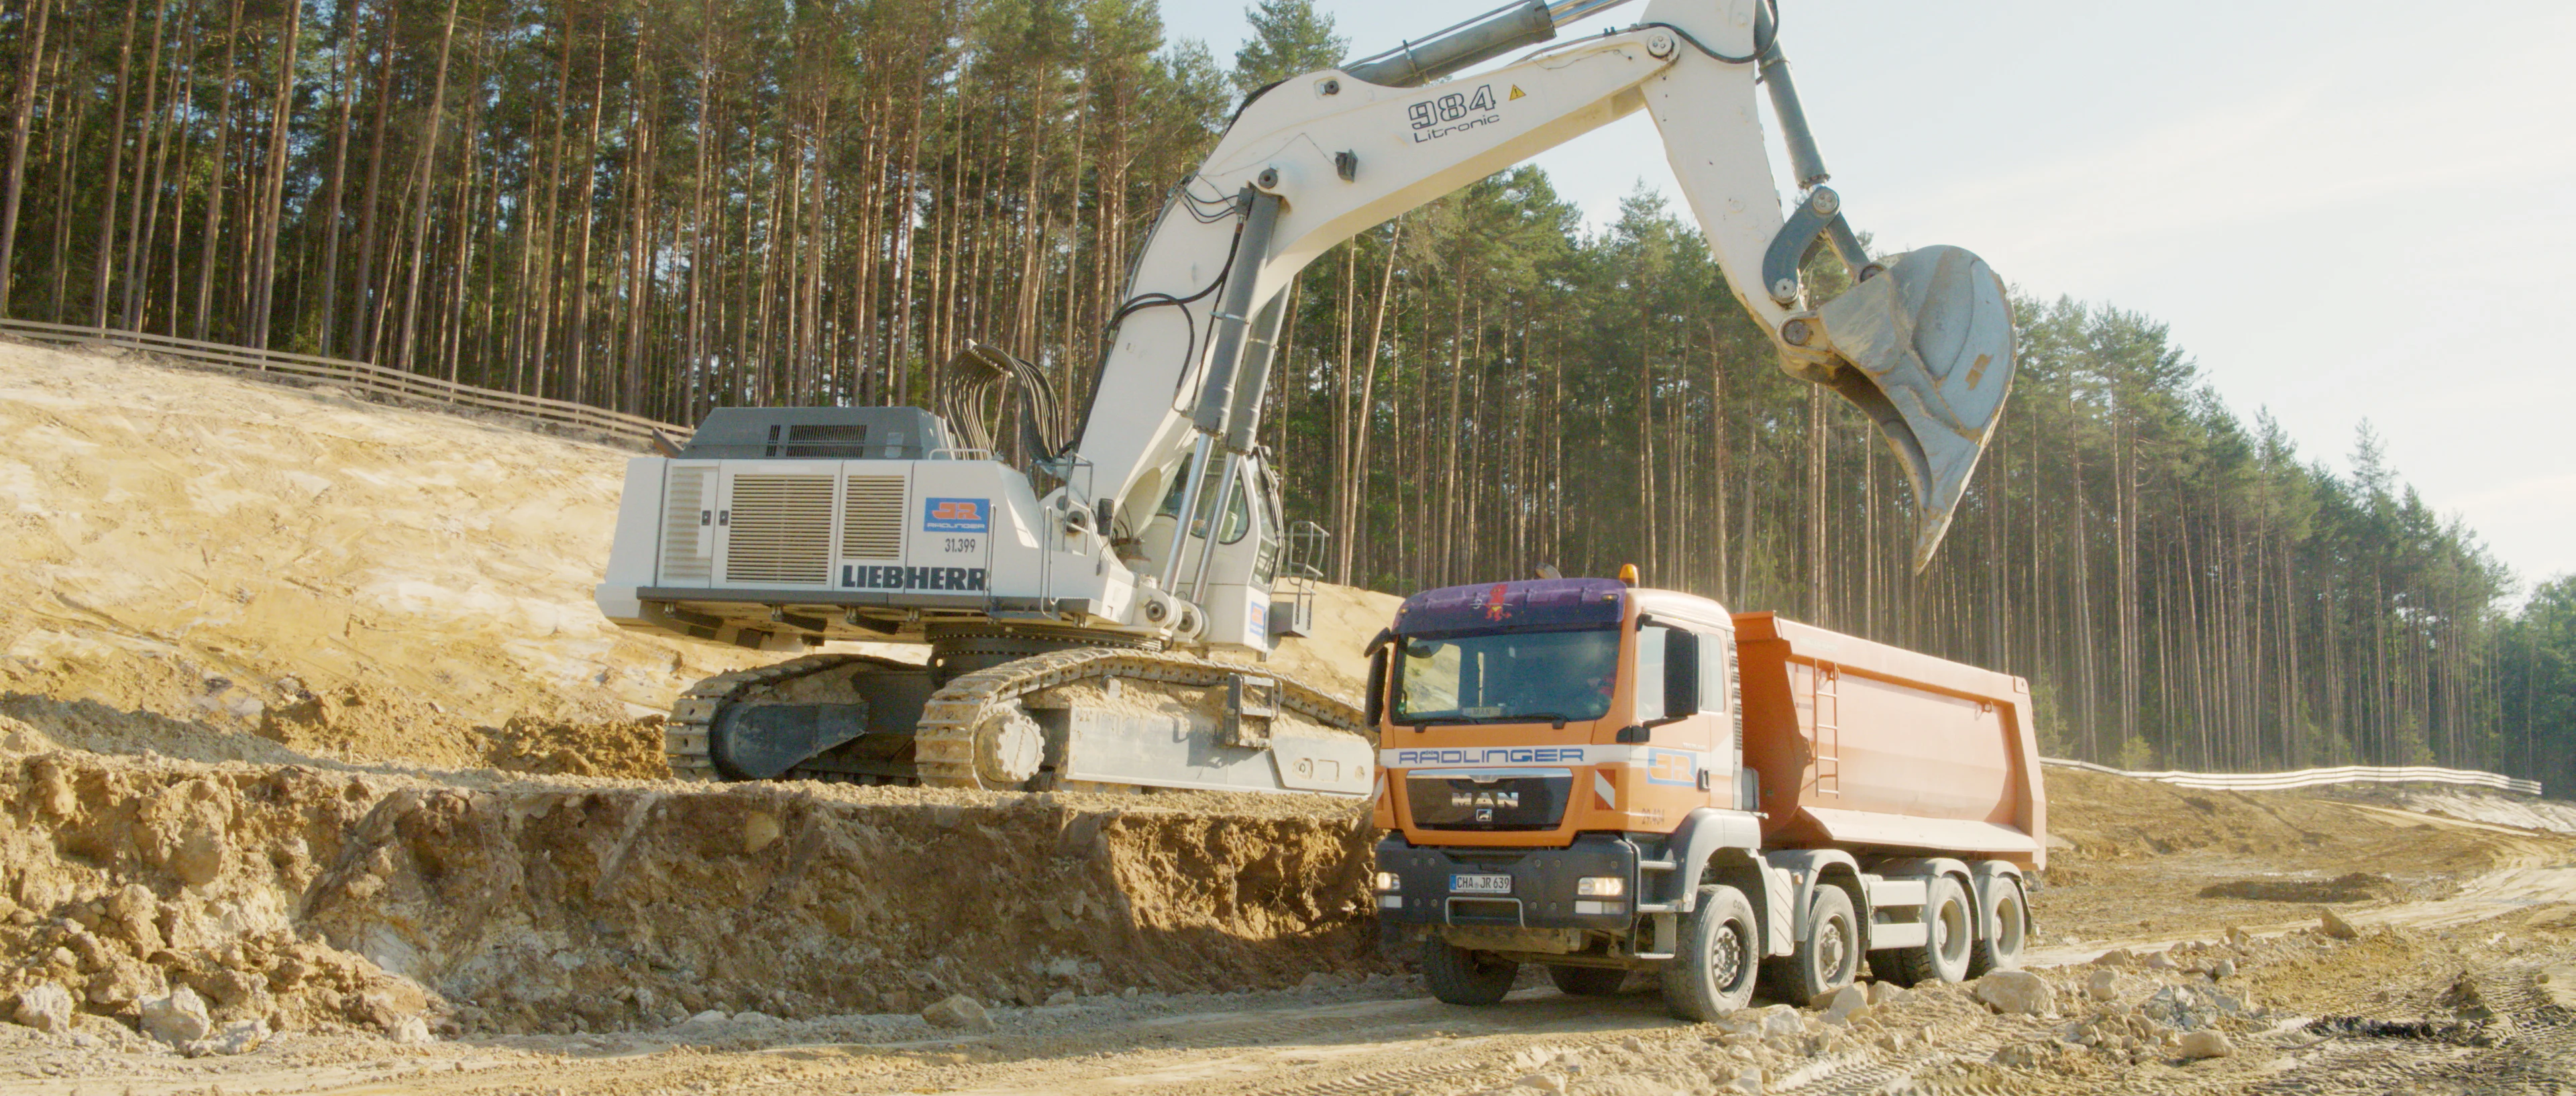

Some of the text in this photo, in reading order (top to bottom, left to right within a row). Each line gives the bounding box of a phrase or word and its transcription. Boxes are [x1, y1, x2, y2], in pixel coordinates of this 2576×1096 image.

[1408, 85, 1496, 129] 984
[1413, 114, 1500, 143] Litronic
[945, 538, 975, 553] 31.399
[842, 565, 990, 591] LIEBHERR
[1452, 792, 1519, 808] MAN
[1457, 877, 1509, 889] CHA JR 639
